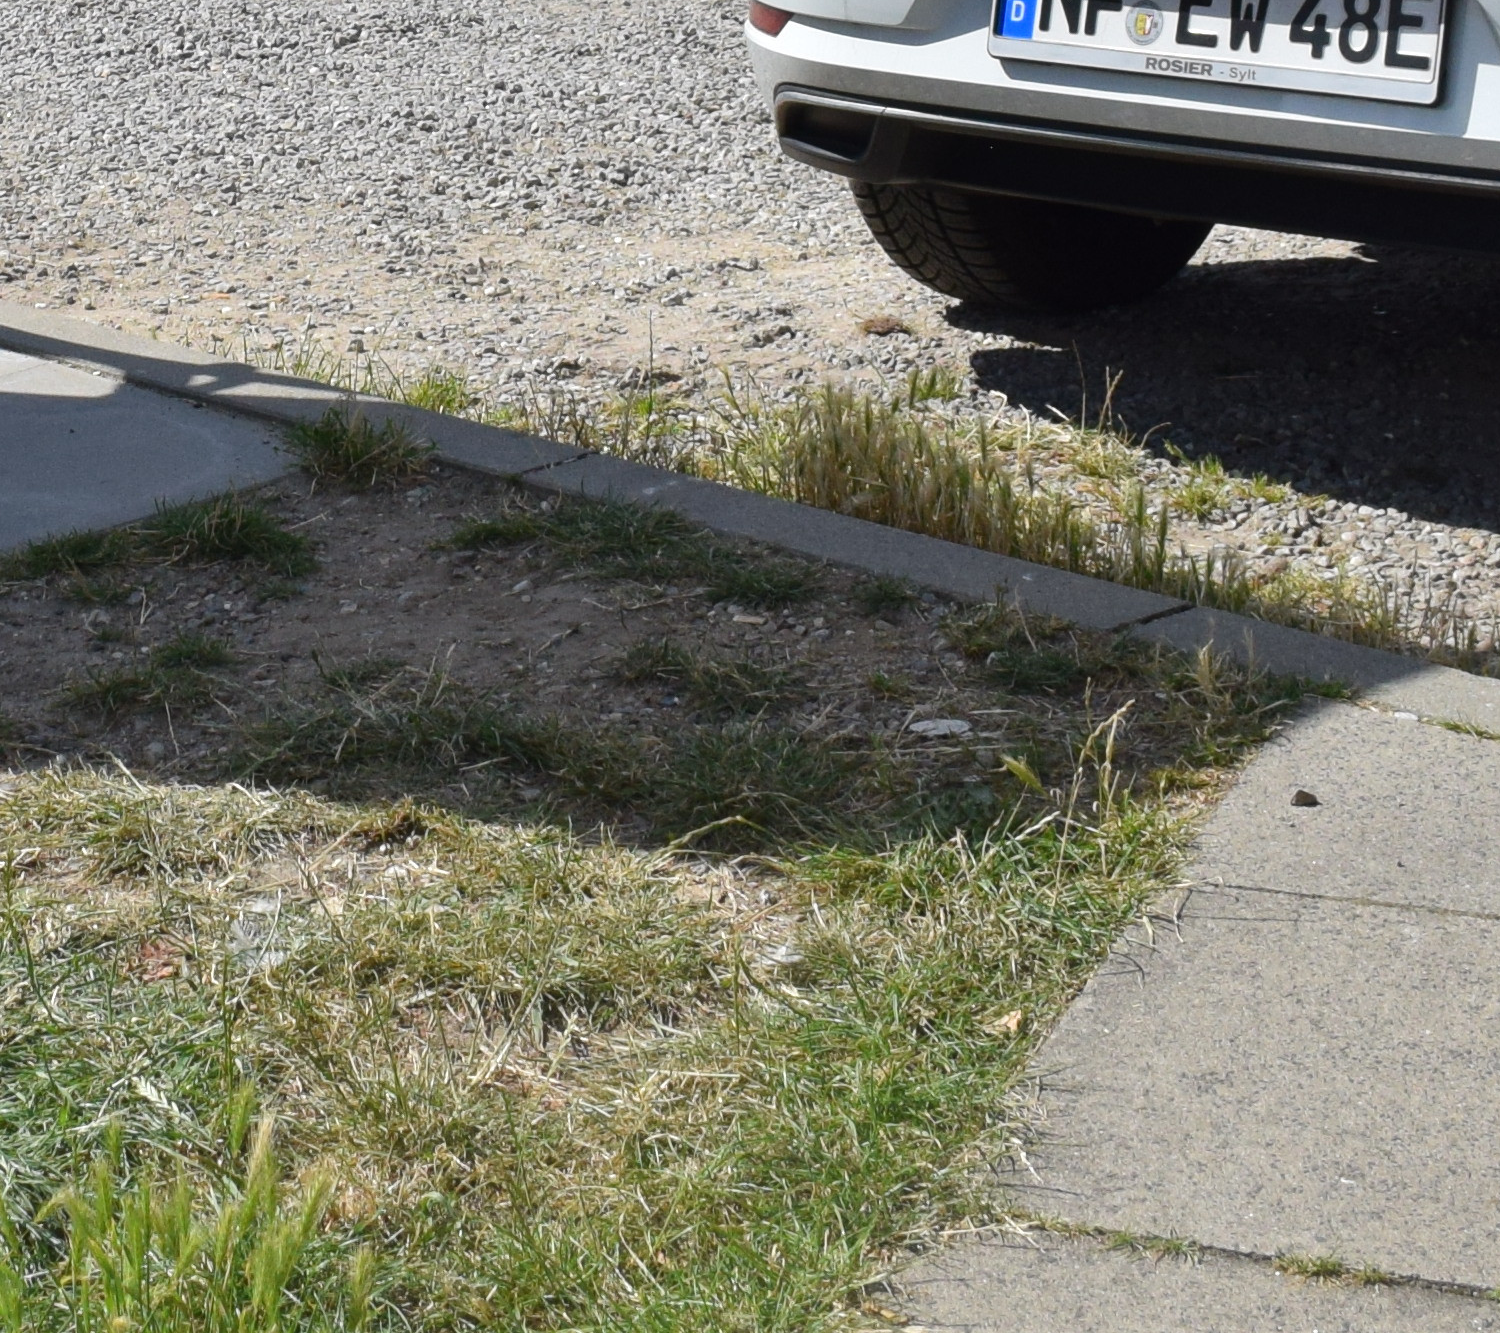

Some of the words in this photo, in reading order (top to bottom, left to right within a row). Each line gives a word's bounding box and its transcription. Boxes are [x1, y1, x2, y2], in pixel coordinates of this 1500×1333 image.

[1010, 0, 1025, 22] D
[1145, 56, 1214, 77] ROSIER
[1228, 65, 1257, 81] Sylt
